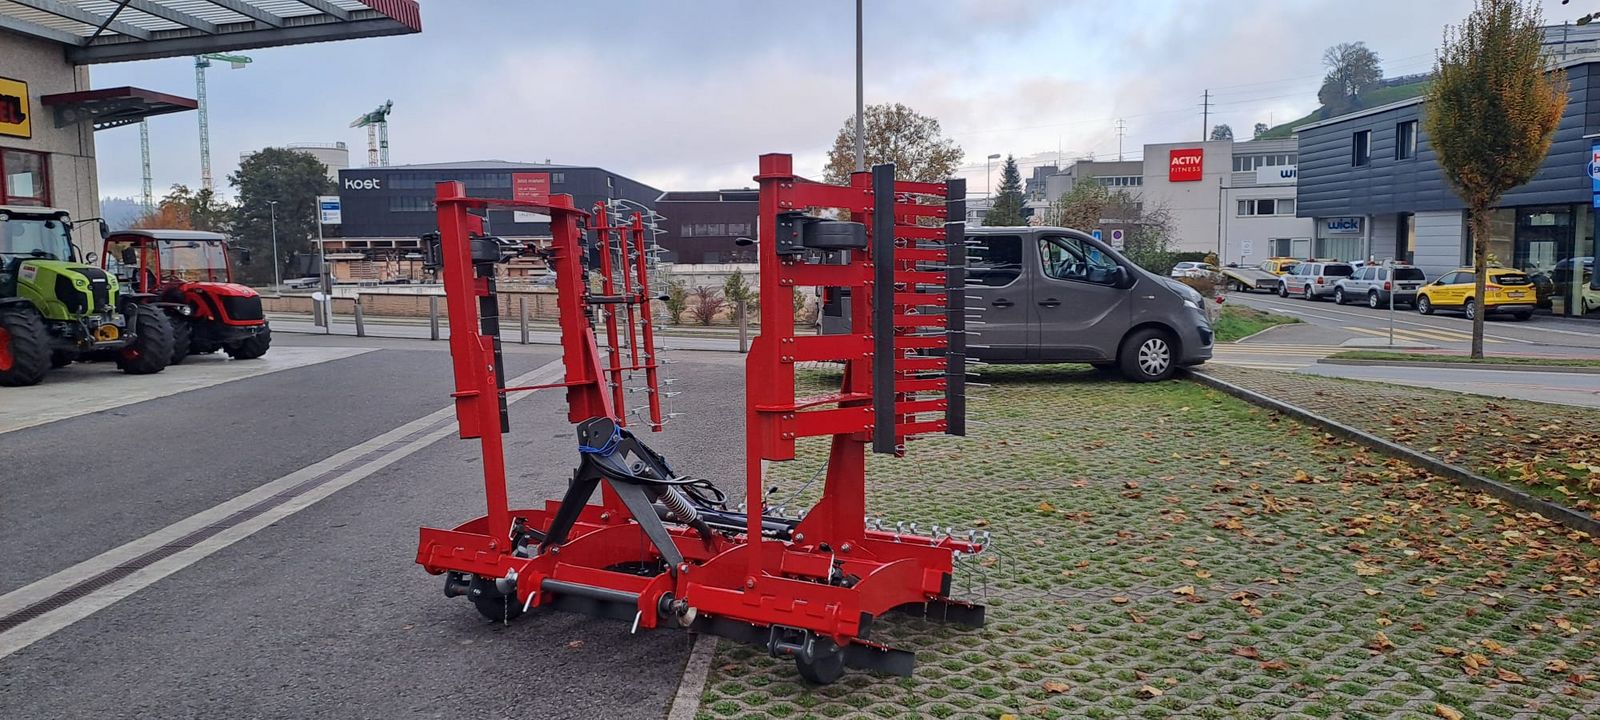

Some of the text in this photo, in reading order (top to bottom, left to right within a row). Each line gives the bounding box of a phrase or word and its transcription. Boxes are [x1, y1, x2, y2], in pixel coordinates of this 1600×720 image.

[1171, 155, 1202, 165] ACTIV
[344, 178, 381, 189] kost
[1328, 218, 1358, 229] wick
